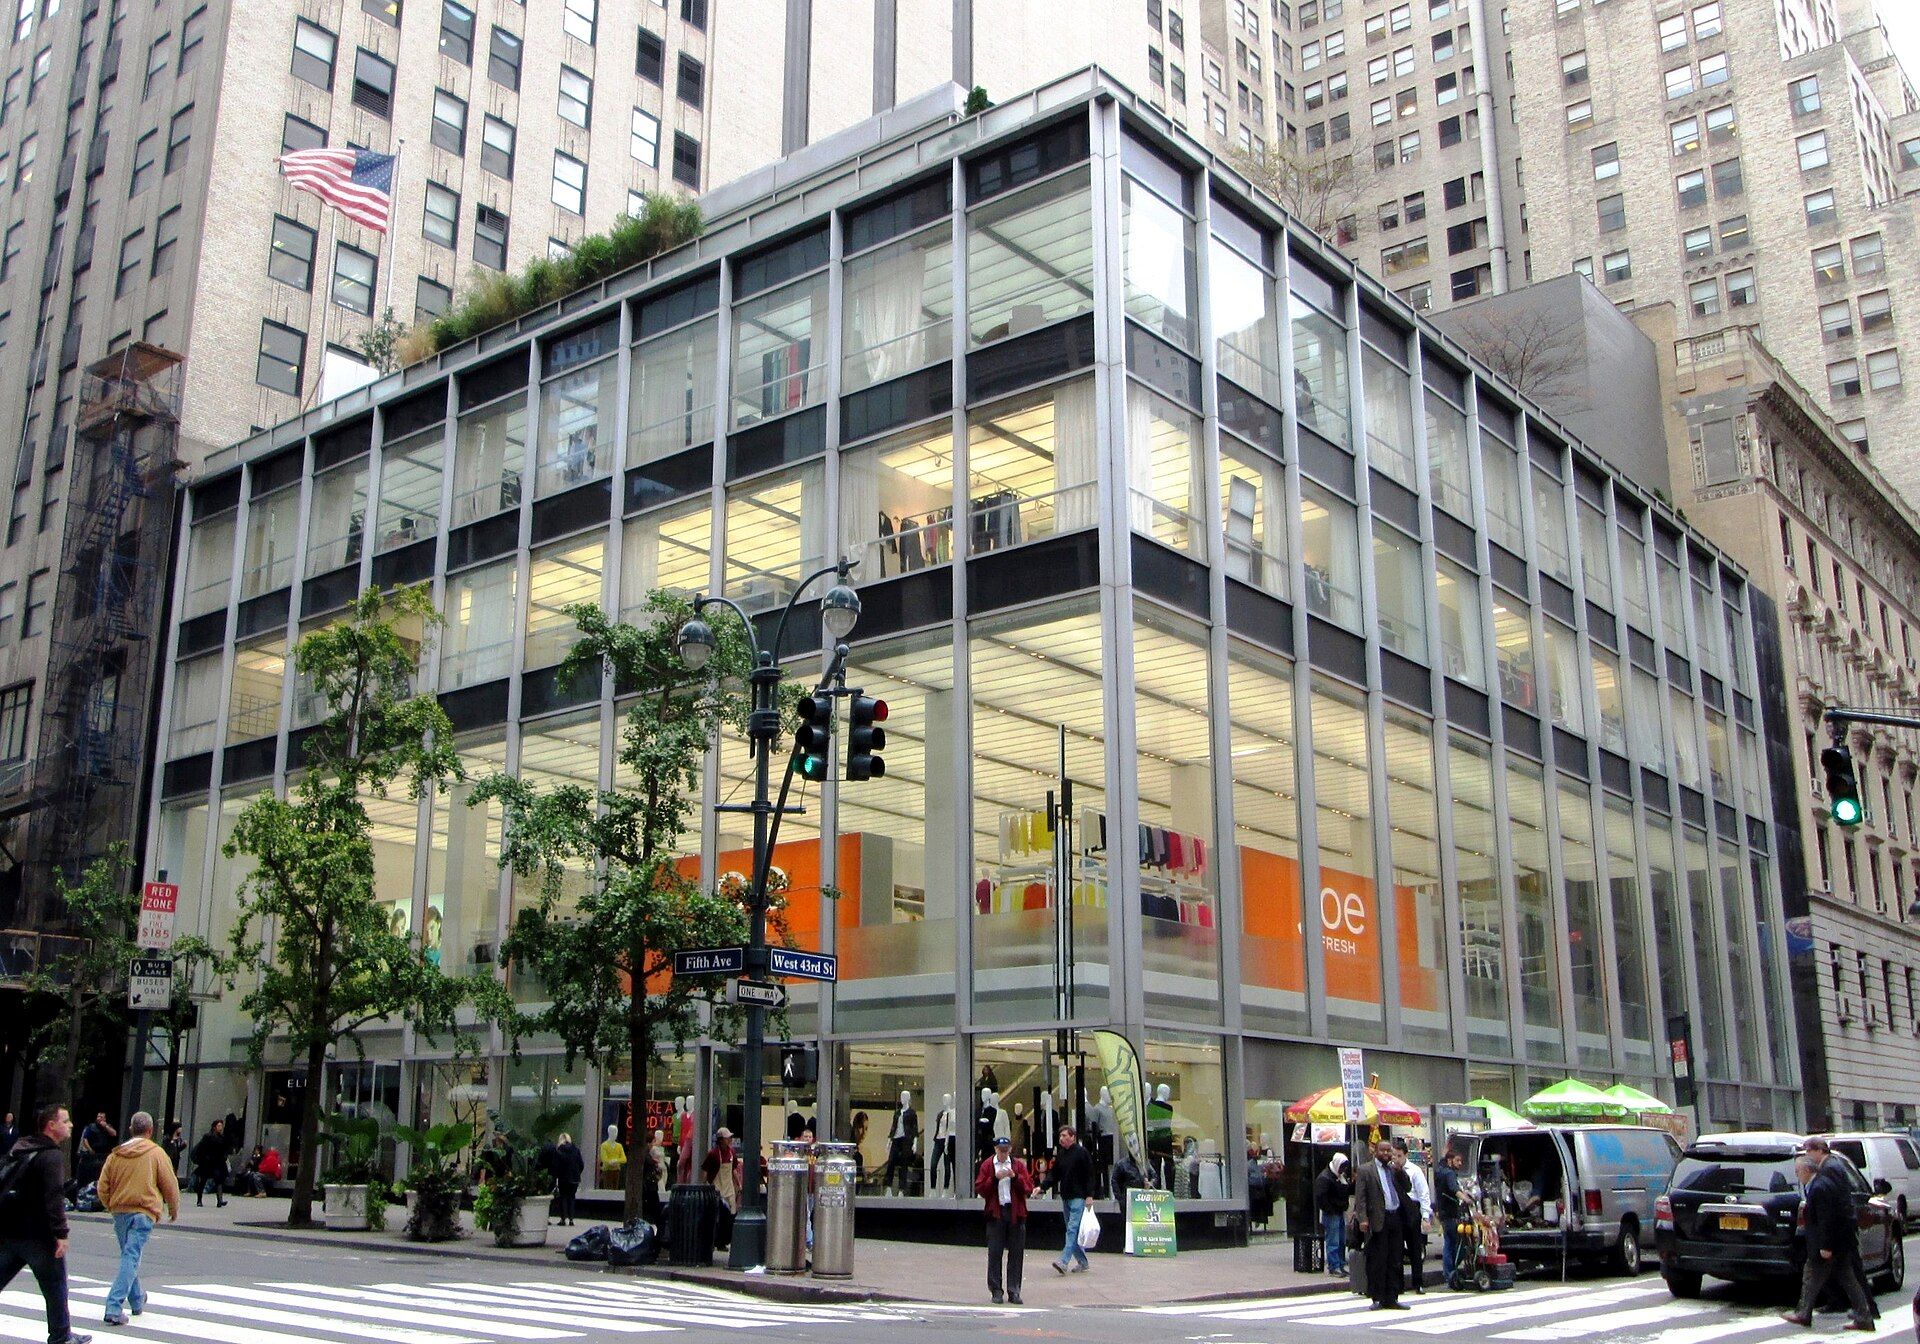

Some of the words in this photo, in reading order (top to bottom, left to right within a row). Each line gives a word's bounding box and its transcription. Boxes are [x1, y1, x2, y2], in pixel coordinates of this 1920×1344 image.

[151, 887, 172, 898] RED
[146, 899, 173, 910] ZONE
[1298, 887, 1365, 935] oe
[142, 927, 169, 939] $185
[686, 956, 710, 970] Fifth
[712, 955, 732, 968] Ave
[774, 955, 798, 971] West
[800, 959, 821, 974] 43rd
[823, 961, 833, 976] St
[136, 978, 164, 986] BUSES
[144, 987, 166, 995] ONLY
[740, 987, 756, 998] ONE
[764, 989, 779, 1000] WAY
[1135, 1194, 1167, 1202] SUBWAY
